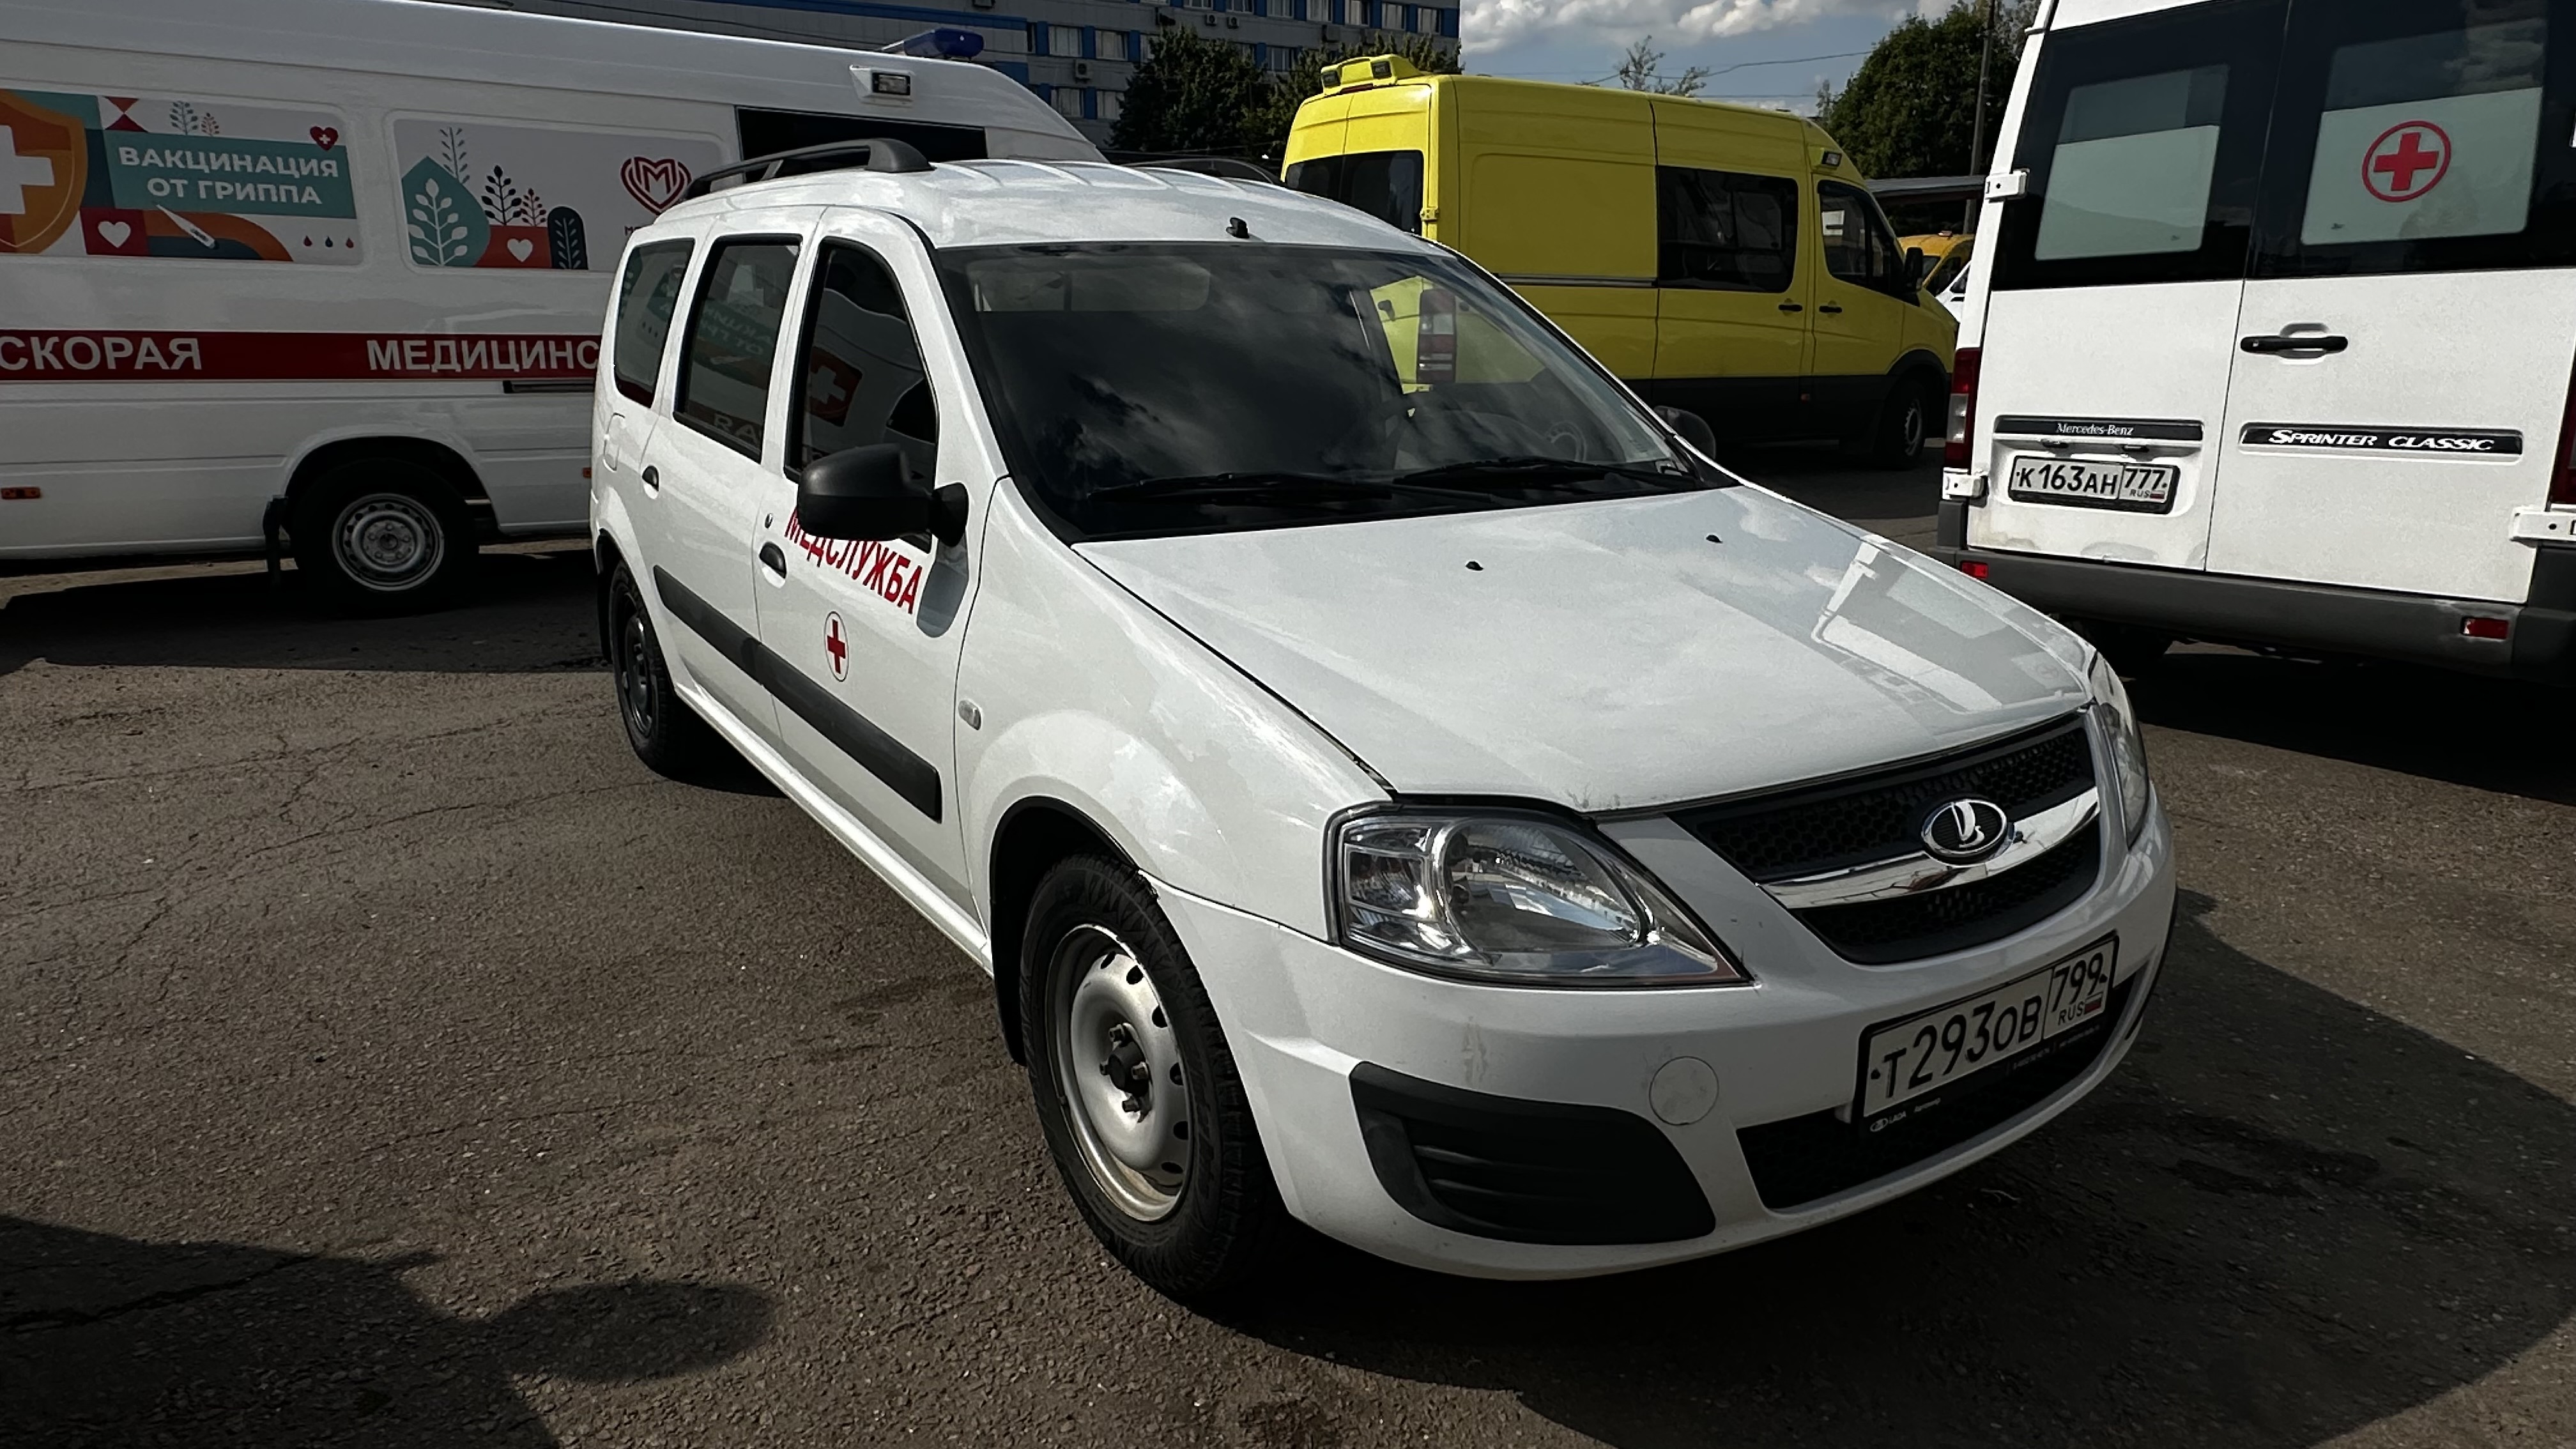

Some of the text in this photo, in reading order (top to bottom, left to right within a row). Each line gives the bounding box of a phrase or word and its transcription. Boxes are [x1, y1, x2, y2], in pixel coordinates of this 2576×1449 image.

[118, 147, 338, 179] ВАКЦИНАЦИЯ
[147, 179, 322, 204] ОТ ГРИППА
[0, 336, 599, 372] СКОРАЯ МЕДИЦИНС
[2057, 422, 2135, 436] Mercedes-Benz
[2268, 429, 2495, 451] SPRINTER CLASSIC
[2018, 464, 2166, 495] К163АН 777
[2129, 488, 2150, 498] RUS
[1883, 952, 2104, 1098] Т293ОВ 799
[2058, 1002, 2085, 1026] RUS
